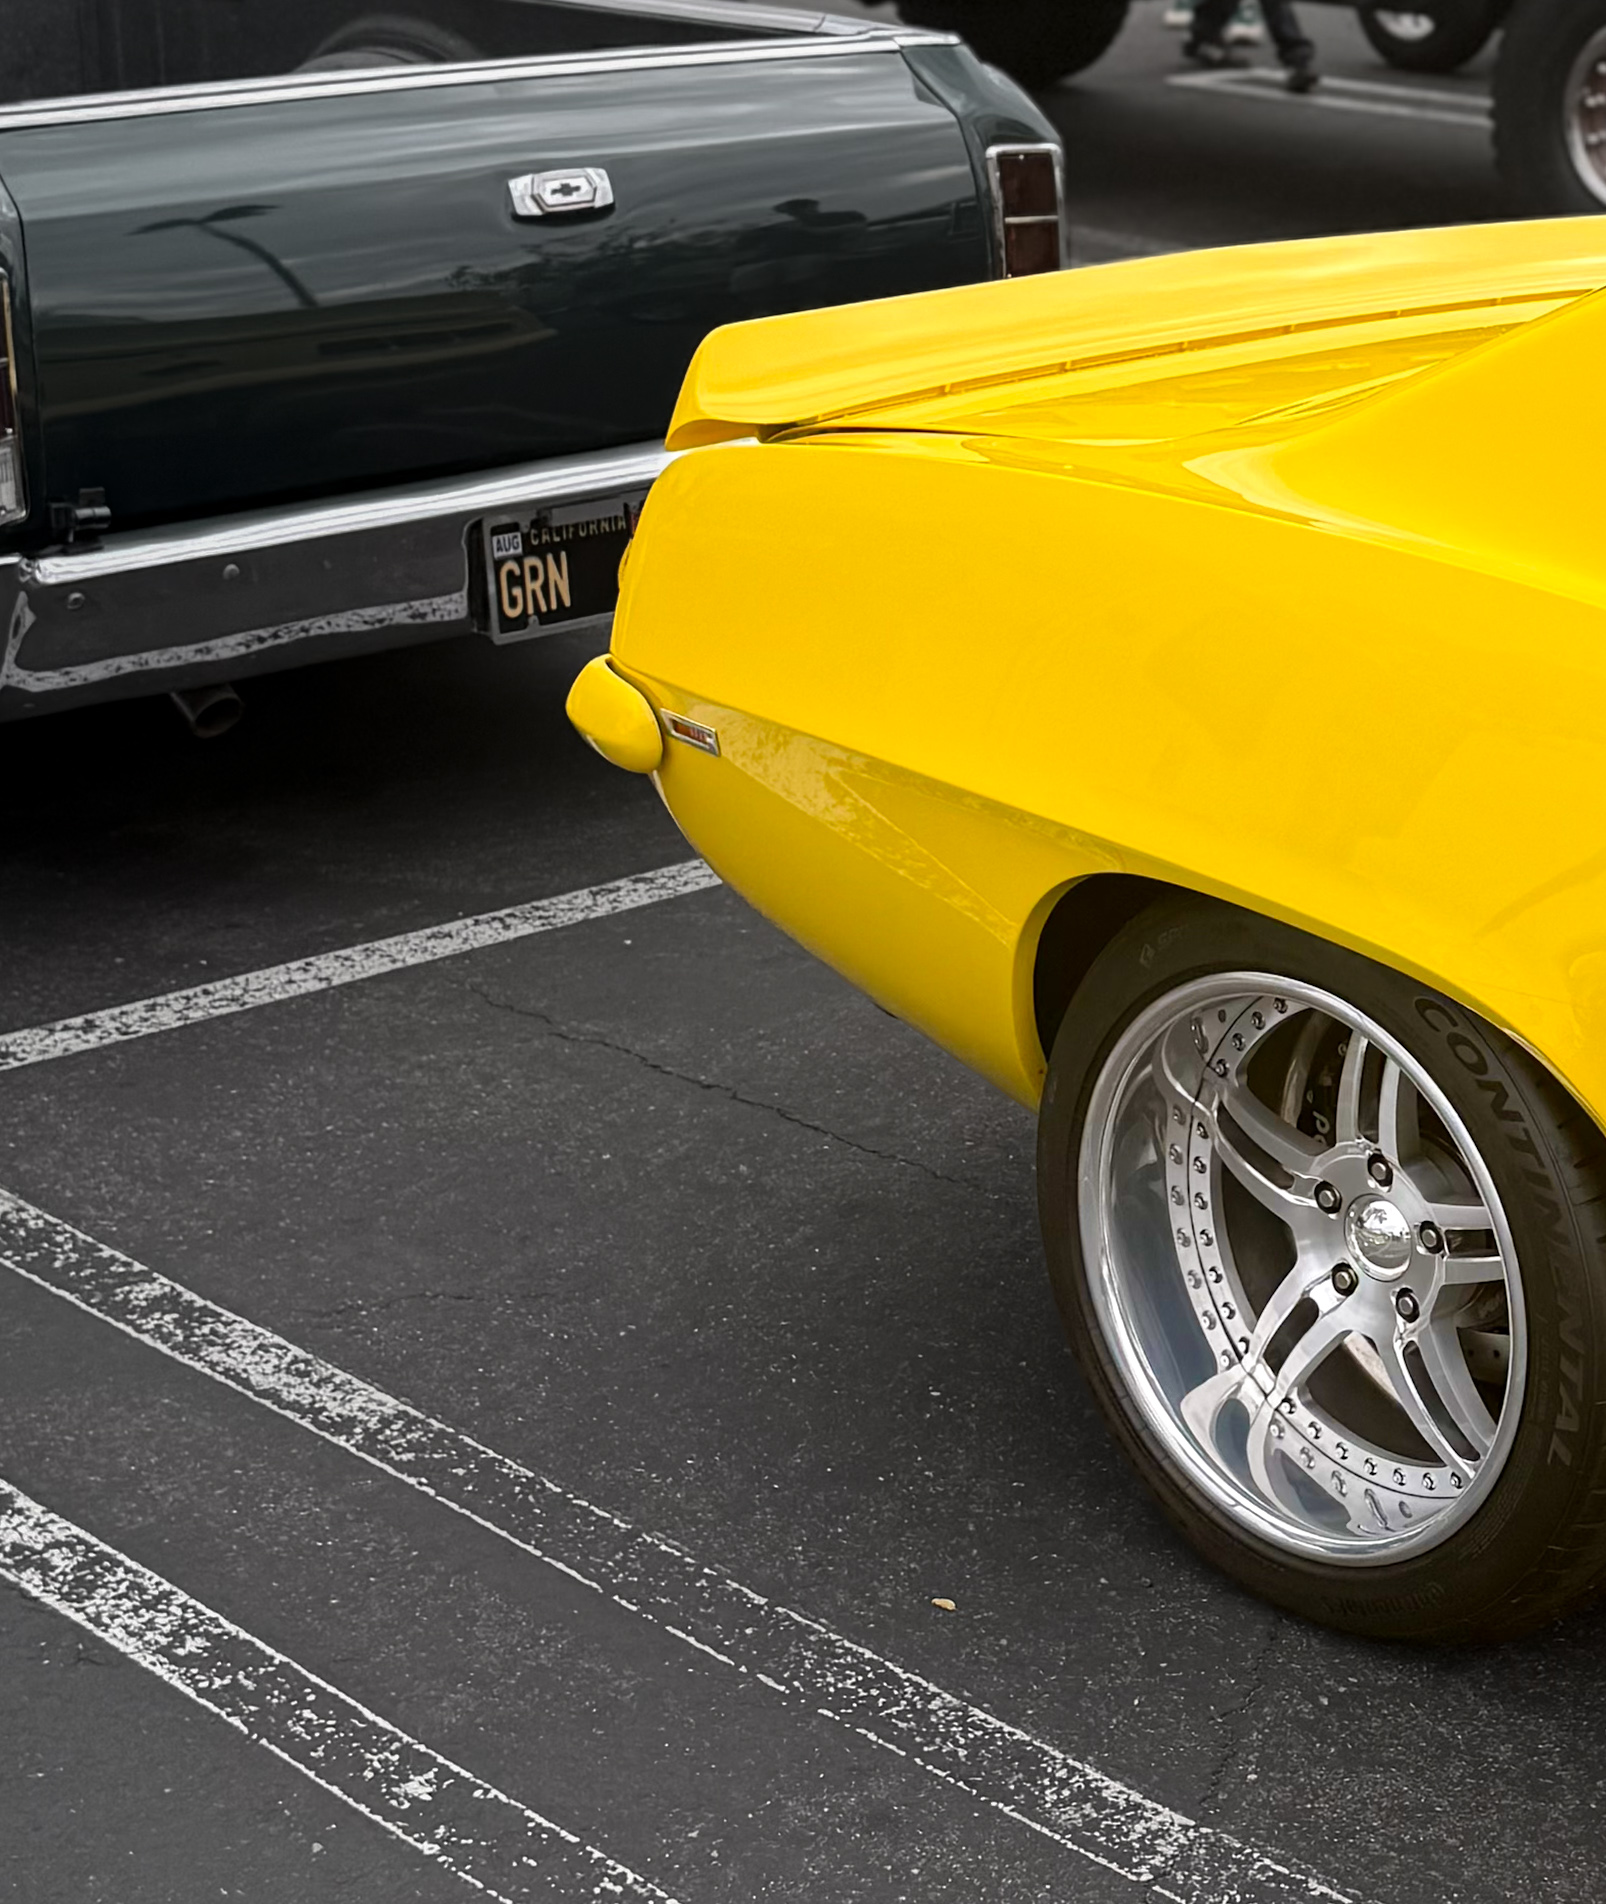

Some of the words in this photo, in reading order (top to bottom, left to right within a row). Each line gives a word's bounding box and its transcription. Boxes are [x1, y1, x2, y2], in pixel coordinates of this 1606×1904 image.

[496, 533, 520, 554] AUG
[531, 518, 626, 545] CALIFORNIA
[500, 551, 571, 618] GRN
[1413, 997, 1586, 1468] CONTINENTAL
